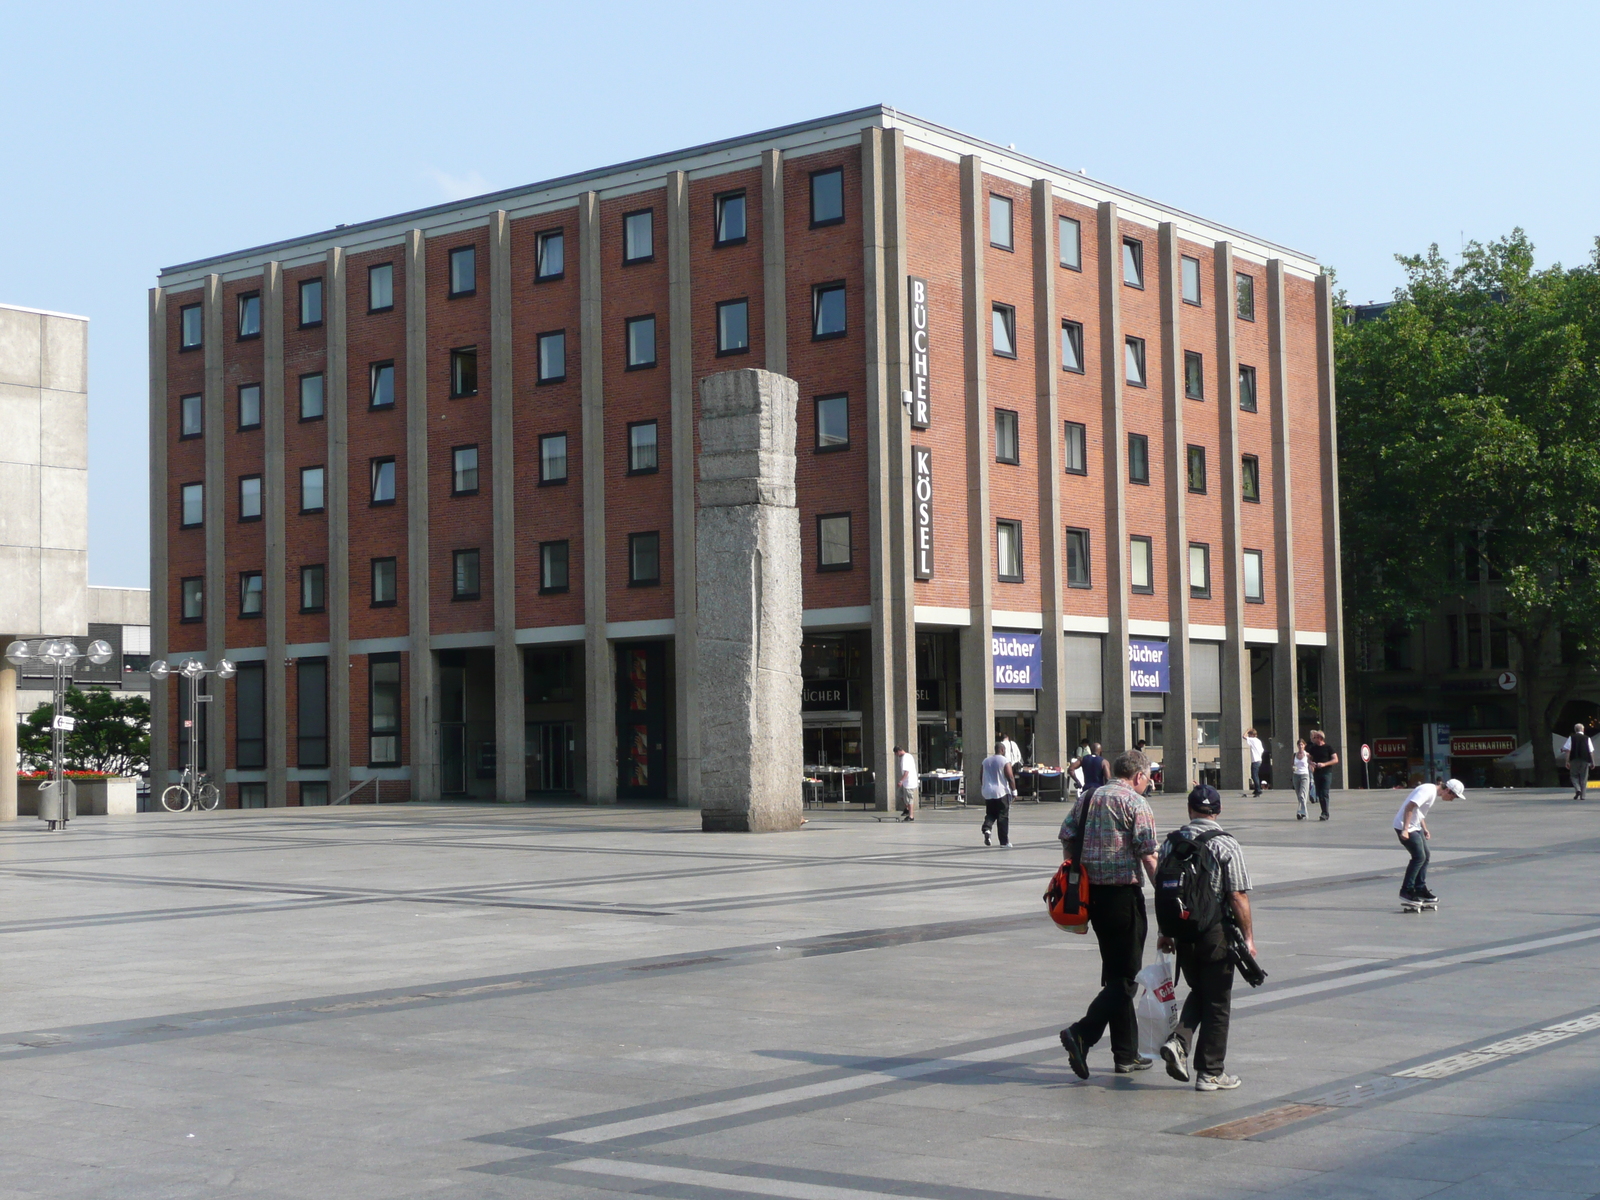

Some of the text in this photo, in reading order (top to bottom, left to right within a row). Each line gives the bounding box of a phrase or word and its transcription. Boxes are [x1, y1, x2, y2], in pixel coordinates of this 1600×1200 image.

[914, 280, 928, 424] BÜCHER
[917, 452, 931, 574] KÖSEL
[992, 638, 1035, 657] Bücher
[995, 665, 1031, 684] Kösel
[1130, 670, 1160, 688] Kösel
[1378, 743, 1406, 753] SOUVEN
[1453, 741, 1513, 751] GESCHENKARTIKEL
